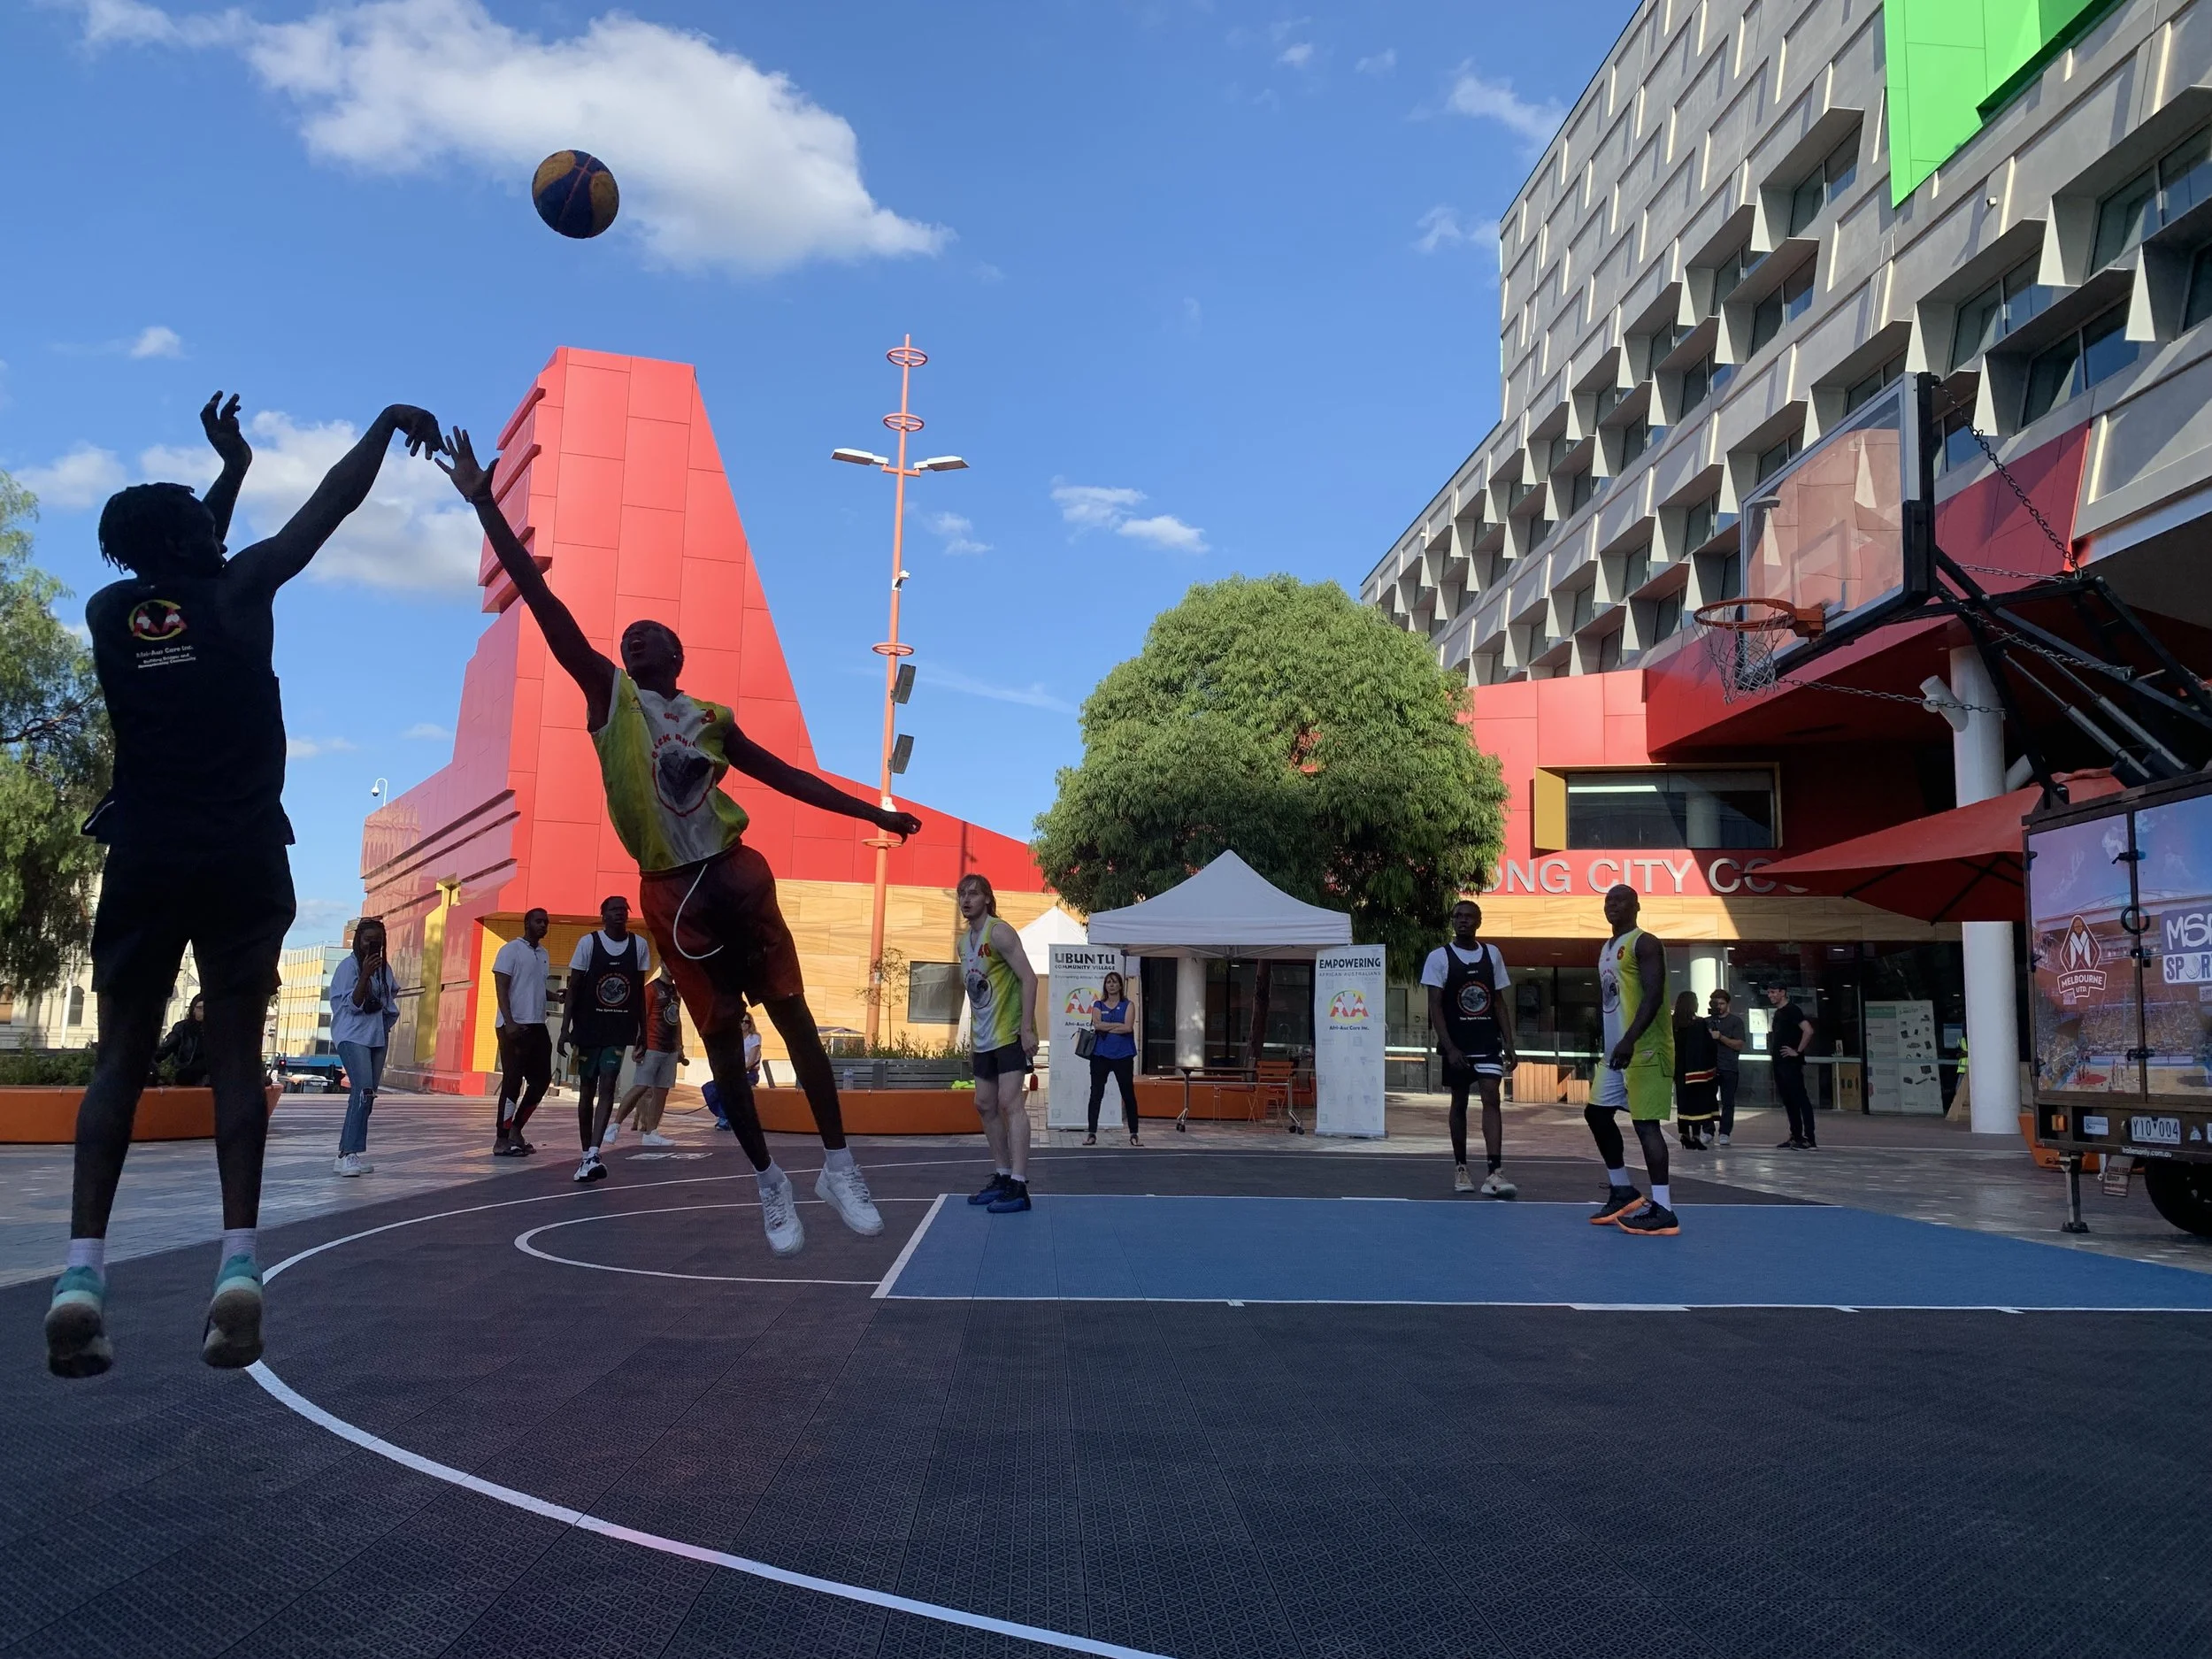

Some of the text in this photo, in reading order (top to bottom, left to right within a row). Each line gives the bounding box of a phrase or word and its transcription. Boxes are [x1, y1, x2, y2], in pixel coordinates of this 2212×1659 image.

[1587, 858, 1694, 894] CITY
[1709, 857, 1809, 894] CO
[978, 942, 991, 957] 40
[1055, 953, 1115, 964] UBUNTU
[1319, 957, 1380, 969] EMPOWERING
[2166, 955, 2212, 980] SPOR
[2062, 974, 2103, 988] MELBOURNE
[2133, 1120, 2178, 1138] Y10 004
